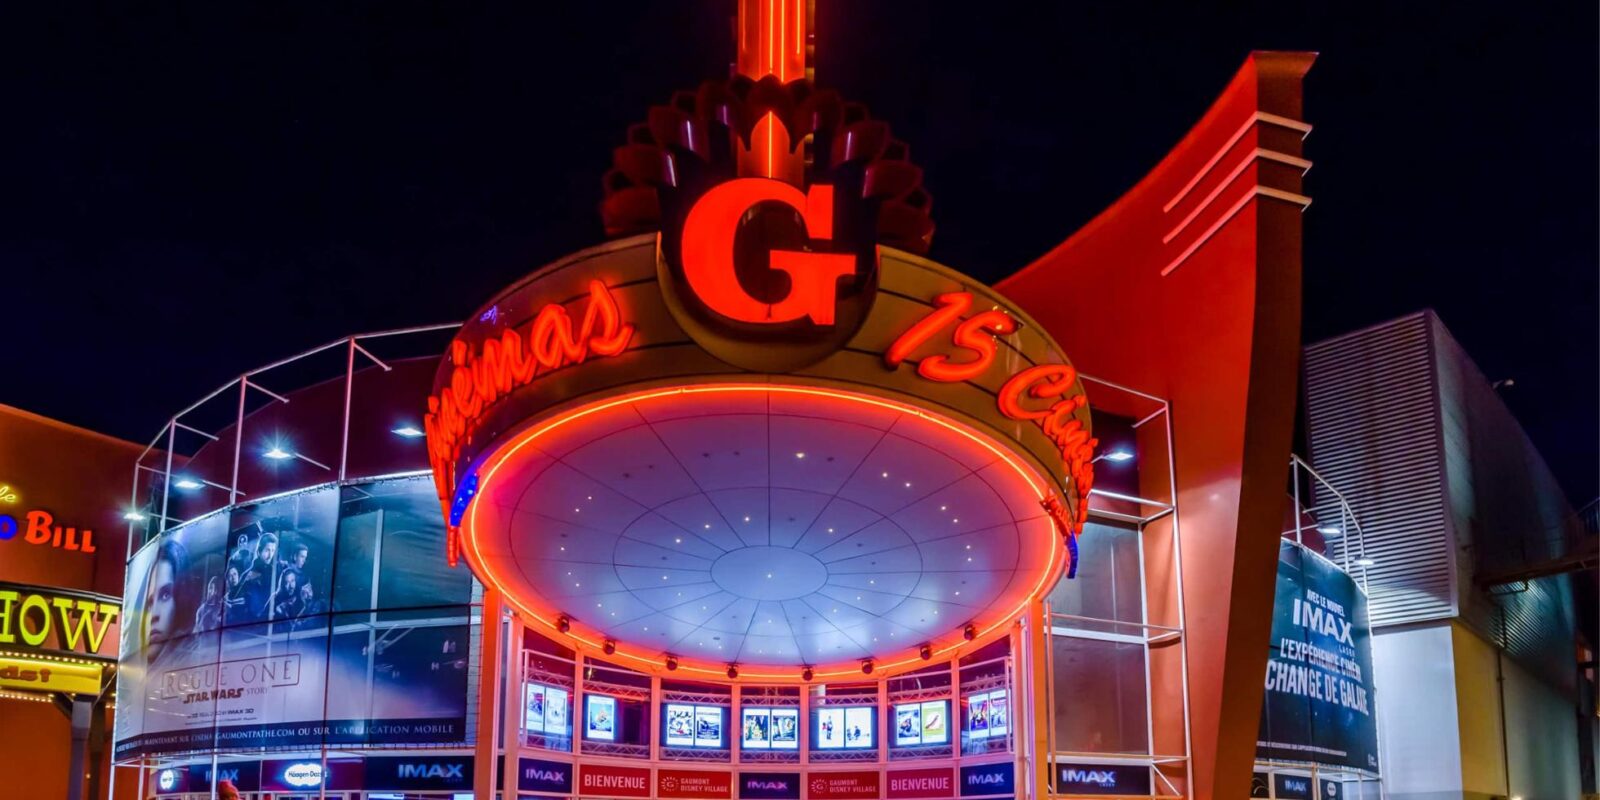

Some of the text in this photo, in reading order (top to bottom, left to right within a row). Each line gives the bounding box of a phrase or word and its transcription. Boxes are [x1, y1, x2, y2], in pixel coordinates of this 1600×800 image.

[681, 177, 857, 325] G
[1320, 595, 1327, 608] LE
[1293, 598, 1355, 648] IMAX
[165, 660, 292, 694] ROGUE ONE
[1264, 659, 1323, 700] CHANGE
[1324, 673, 1339, 705] DE
[183, 691, 210, 704] STAR
[210, 688, 244, 700] WARS
[298, 728, 311, 736] OU
[313, 727, 330, 736] SUR
[414, 724, 454, 734] MOBILE
[205, 769, 239, 781] IAX
[398, 764, 464, 778] IMAX
[525, 768, 565, 781] IMAX
[1062, 769, 1116, 782] IMAX
[584, 774, 646, 789] BIENVENUE
[747, 780, 788, 790] IMAX
[890, 777, 949, 791] BIENVENUE
[967, 773, 1005, 785] IMAX
[1284, 780, 1307, 792] IMAX
